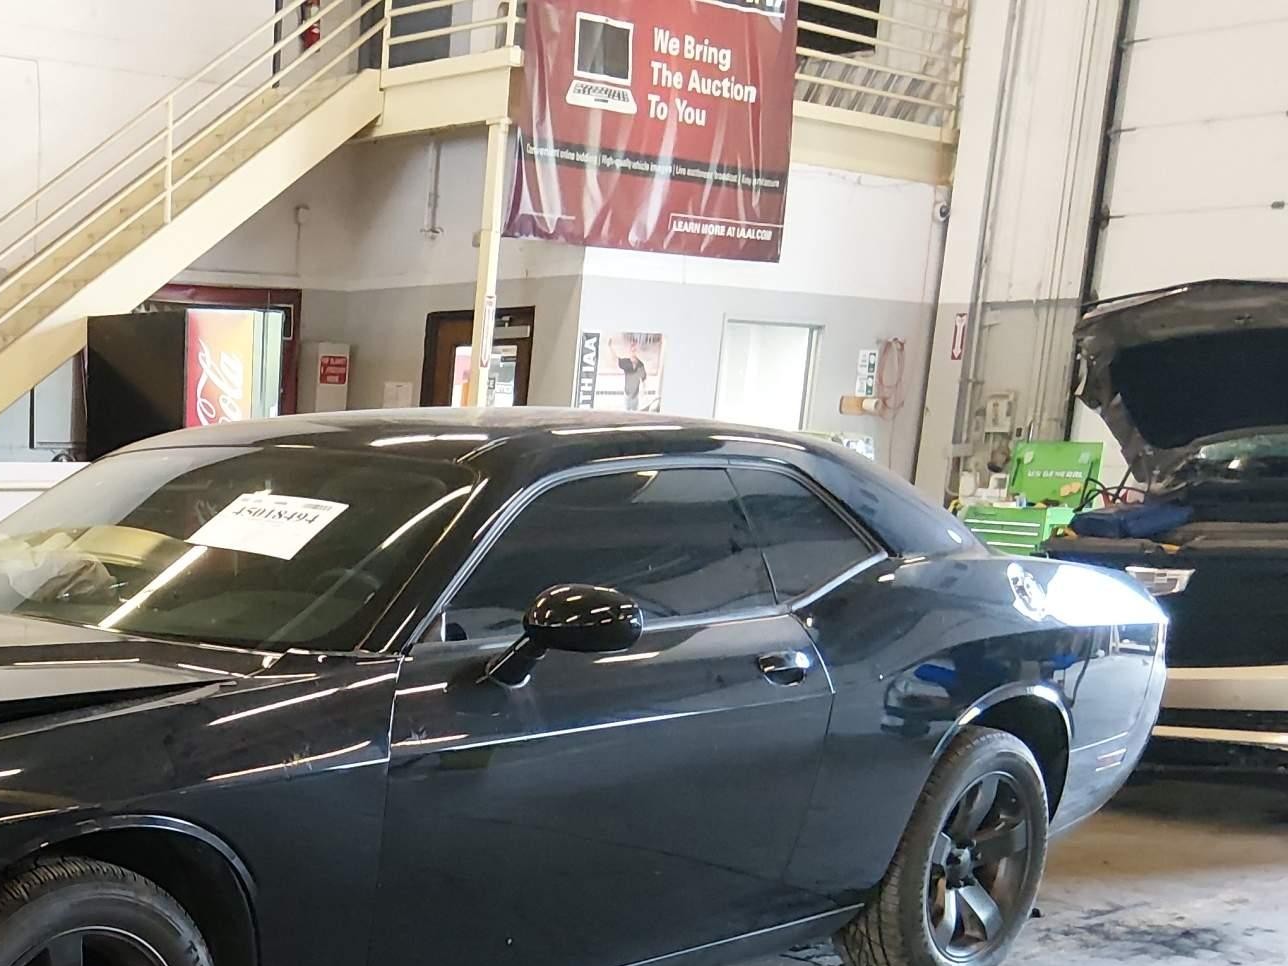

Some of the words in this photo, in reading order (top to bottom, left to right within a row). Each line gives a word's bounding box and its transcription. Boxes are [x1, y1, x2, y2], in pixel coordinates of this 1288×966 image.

[654, 27, 680, 56] We
[684, 34, 732, 71] Bring
[651, 61, 683, 89] The
[688, 69, 757, 103] Auction
[648, 93, 668, 121] To
[675, 98, 706, 126] You
[672, 220, 701, 234] LEARN
[701, 224, 726, 236] MORE
[726, 226, 736, 237] AT
[233, 506, 320, 524] 45018494
